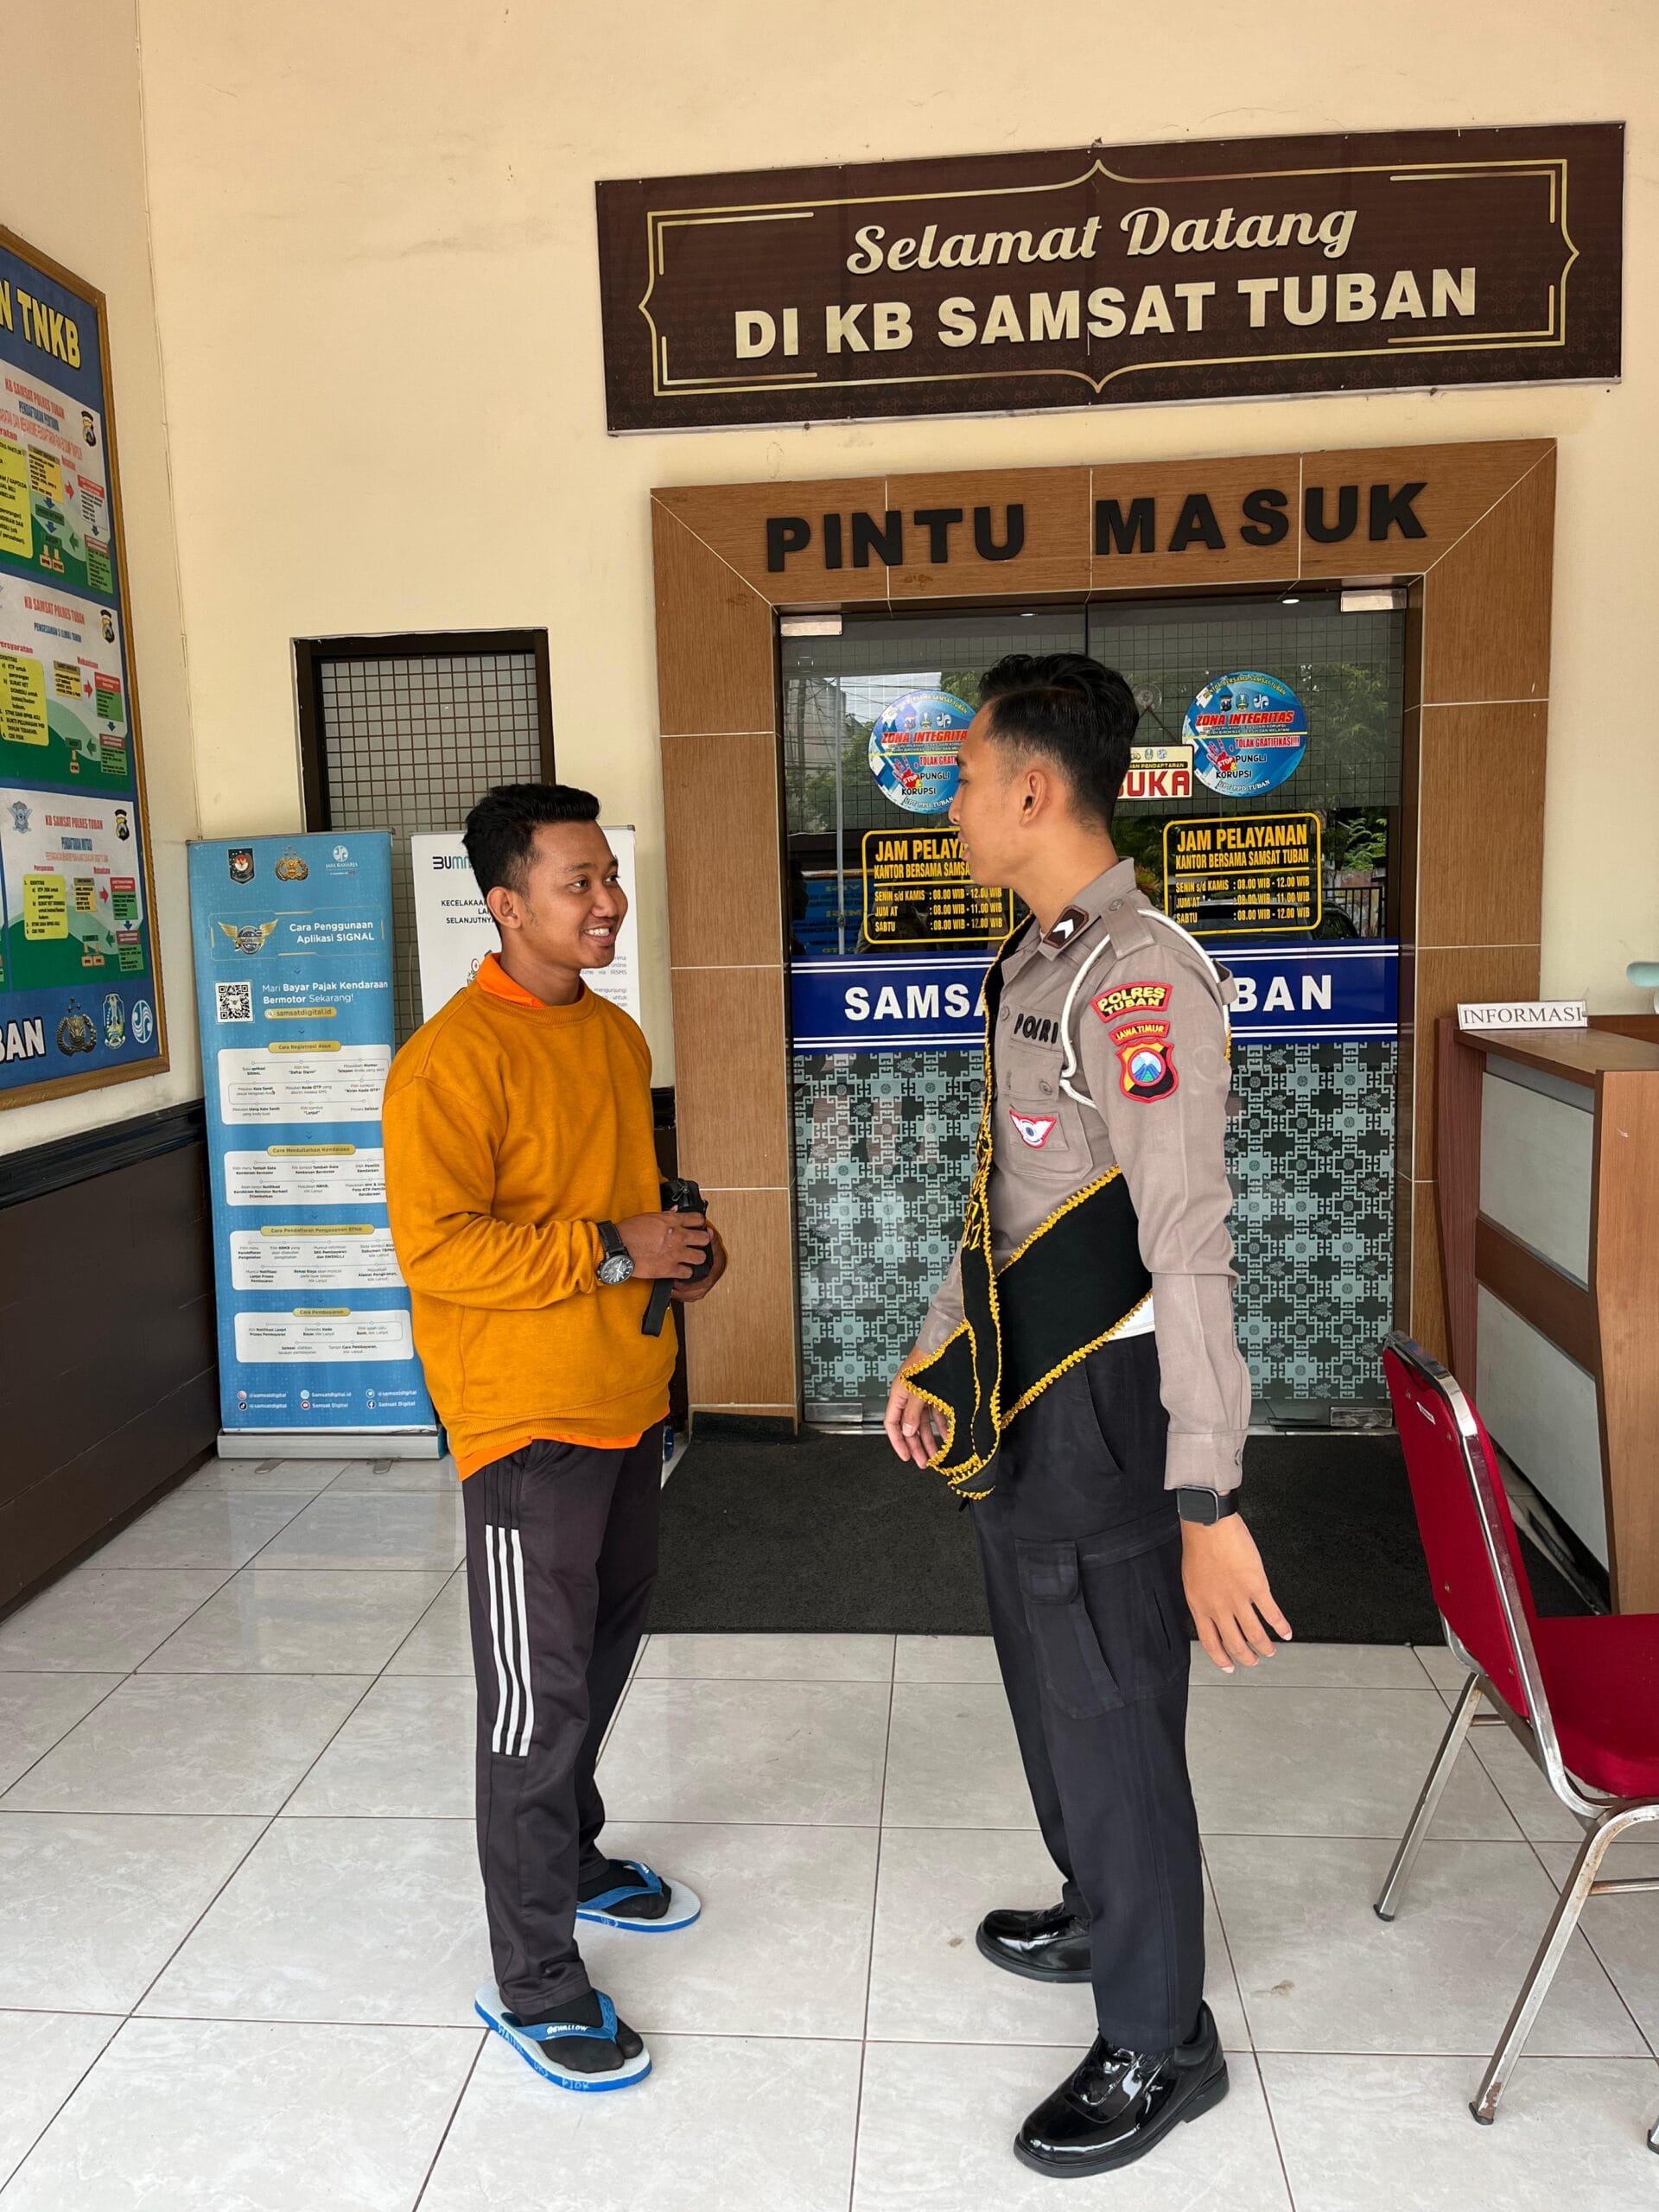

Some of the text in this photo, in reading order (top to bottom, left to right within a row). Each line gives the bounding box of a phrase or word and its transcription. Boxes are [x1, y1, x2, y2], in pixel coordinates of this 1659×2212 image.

[846, 207, 1357, 275] Selamat Datang
[734, 267, 1476, 359] DI KB SAMSAT TUBAN
[16, 287, 81, 370] TNKB
[766, 482, 1428, 573] PINTU MASUK
[33, 598, 54, 615] SAMSAT
[54, 604, 71, 620] POLRES
[0, 641, 33, 653] ersyaratan
[1196, 710, 1294, 726] ZONA INTEGRITAS
[881, 729, 968, 743] ZONA INTEGRITA
[1235, 738, 1255, 748] TOLAK
[919, 756, 938, 766] TOLAK
[1217, 757, 1232, 766] STOP
[903, 774, 918, 785] STOP
[1118, 771, 1190, 797] UKA
[1249, 779, 1270, 791] TUBAN
[1177, 824, 1307, 852] JAM PELAYANAN
[875, 841, 907, 861] JAM
[1176, 848, 1309, 869] KANTOR BERSAMA SAMSAT TUBAN
[874, 861, 970, 879] KANTOR BERSAMA SAMSA
[1176, 875, 1310, 893] SENIN s/d KAMIS 08.00 WIB 12.00 WIB
[874, 891, 893, 901] SENIN
[894, 891, 904, 901] s/d
[905, 890, 925, 900] KAMIS
[933, 889, 950, 899] 08.00
[952, 888, 965, 899] WIB
[989, 887, 1002, 898] WIB
[1257, 893, 1270, 904] WIB
[1296, 891, 1310, 902] WIB
[952, 904, 965, 914] WIB
[970, 903, 988, 913] 11.00
[989, 902, 1002, 912] WIB
[1176, 912, 1198, 924] SABTU
[1257, 909, 1270, 919] WIB
[1277, 908, 1295, 918] 12.00
[1297, 907, 1310, 918] WIB
[314, 921, 373, 933] Penggunaan
[875, 921, 896, 932] SABTU
[952, 918, 965, 930] WIB
[971, 918, 988, 929] 12.00
[989, 918, 1002, 928] WIB
[296, 932, 374, 944] Aplikasi SIGNAL
[283, 983, 309, 993] Bayar
[312, 982, 337, 991] Pajak
[340, 981, 388, 989] Kendaraan
[263, 994, 354, 1004] Bermotor Sekarang!
[844, 975, 1332, 1021] SAMS BAN
[1097, 986, 1166, 1012] POLRES
[276, 1008, 332, 1017] samsatdigital.id
[1103, 998, 1160, 1015] TUBAN
[1464, 1007, 1582, 1024] INFORMASI
[1116, 1025, 1165, 1040] JAWA TIMUR
